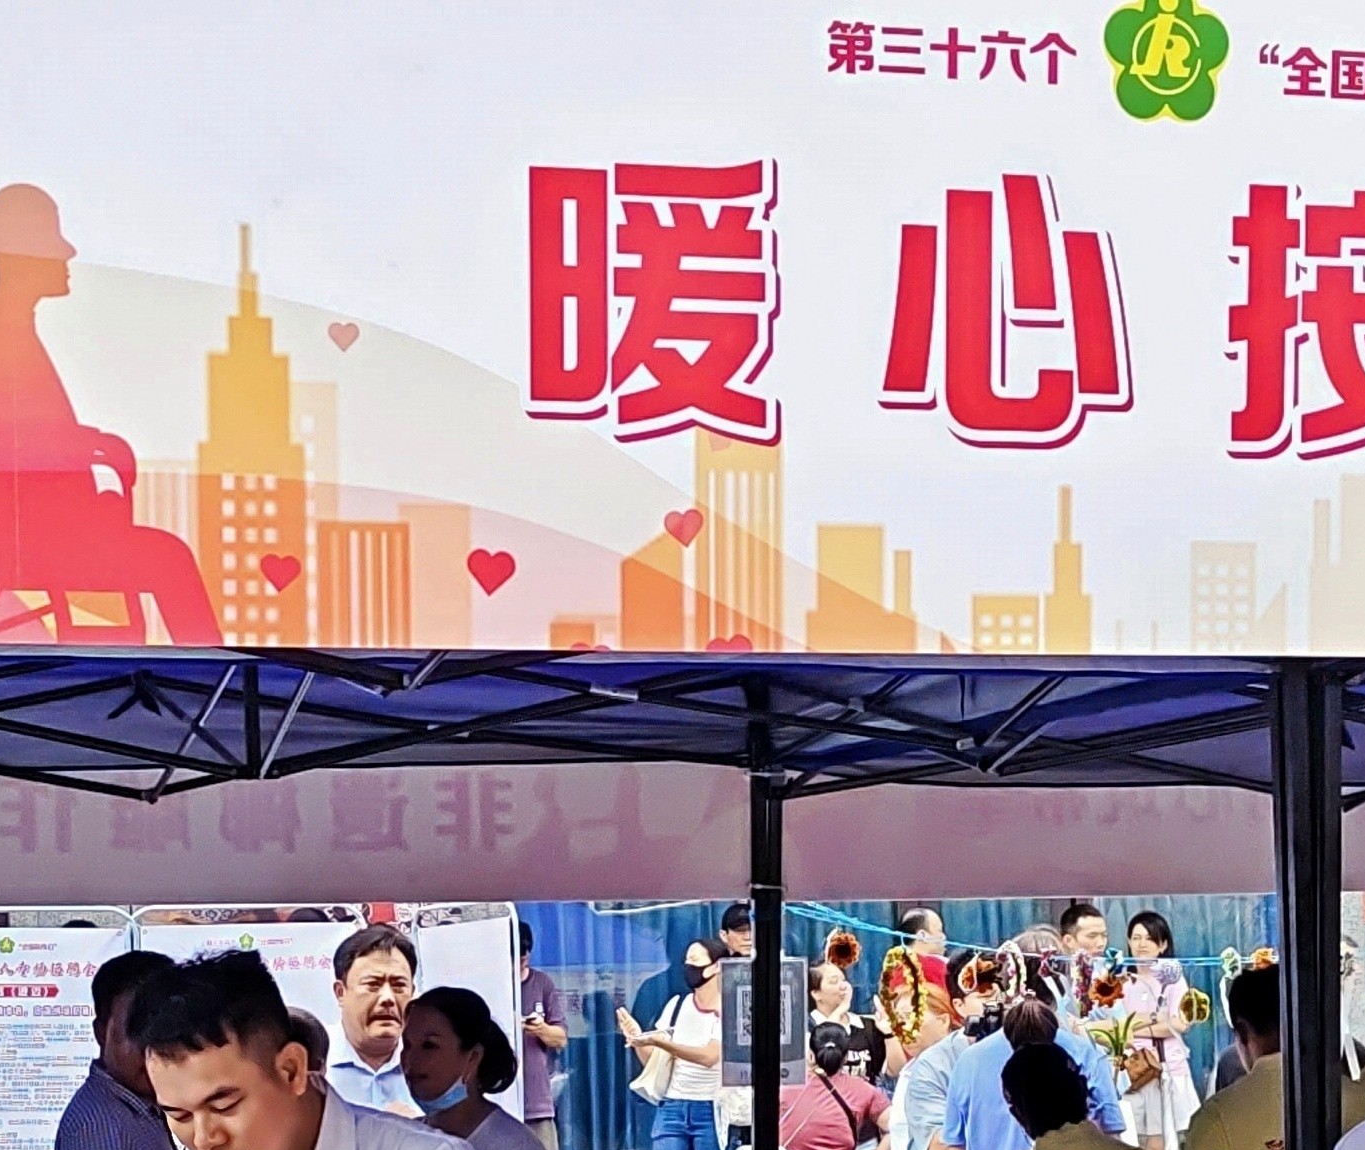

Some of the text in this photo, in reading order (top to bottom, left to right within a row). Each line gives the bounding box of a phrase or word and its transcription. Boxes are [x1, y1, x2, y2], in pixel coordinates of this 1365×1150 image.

[826, 20, 1078, 85] 第三十六个
